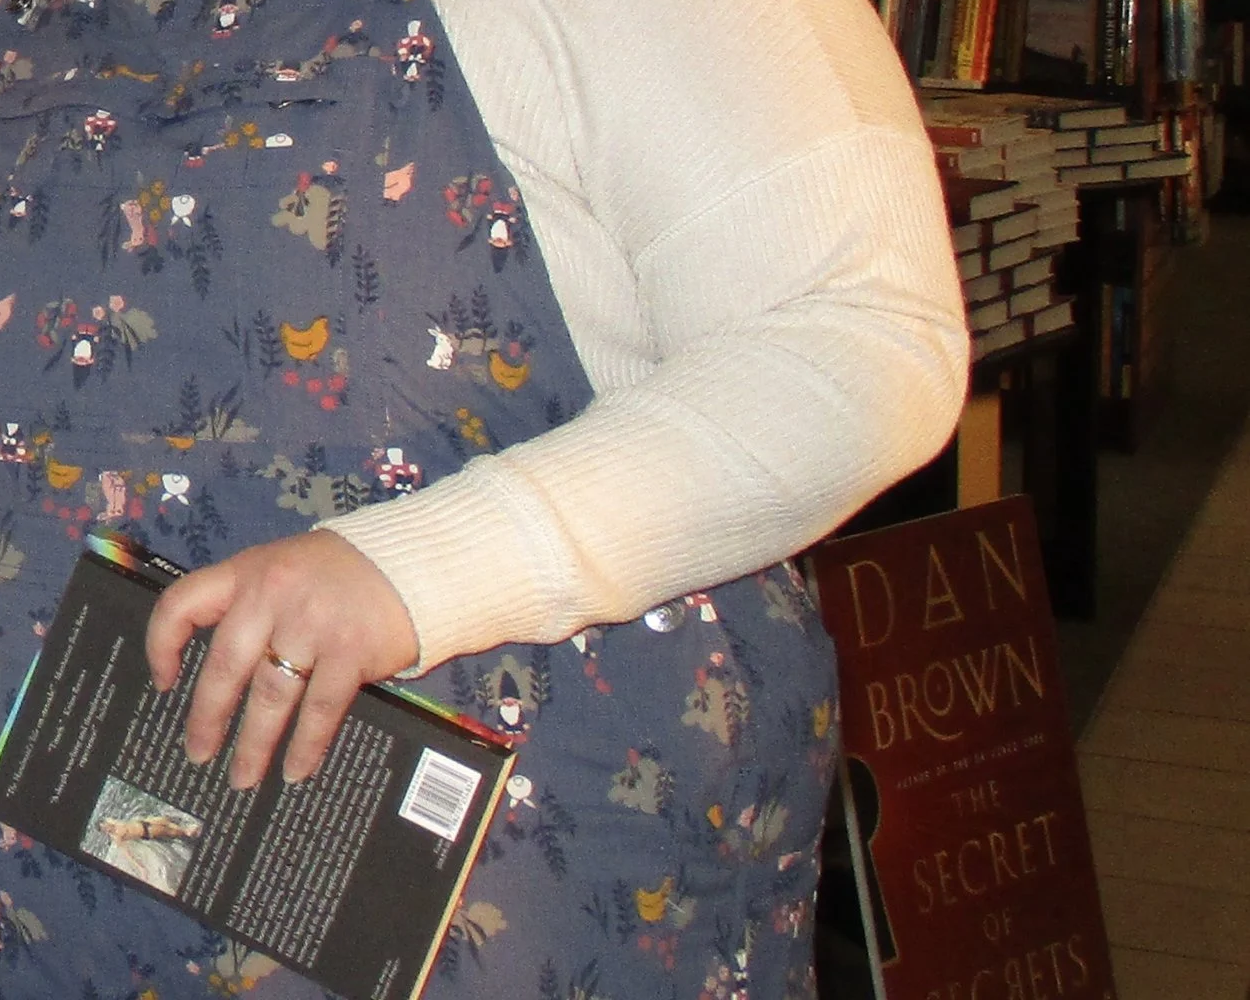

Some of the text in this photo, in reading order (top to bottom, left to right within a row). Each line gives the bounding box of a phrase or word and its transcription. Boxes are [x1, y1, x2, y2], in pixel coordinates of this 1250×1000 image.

[847, 523, 1028, 649] DAN
[865, 636, 1044, 752] BROWN
[951, 780, 1002, 815] THE
[912, 812, 1057, 914] SECRET
[983, 907, 1014, 941] OF
[927, 935, 1090, 1000] CRETS
